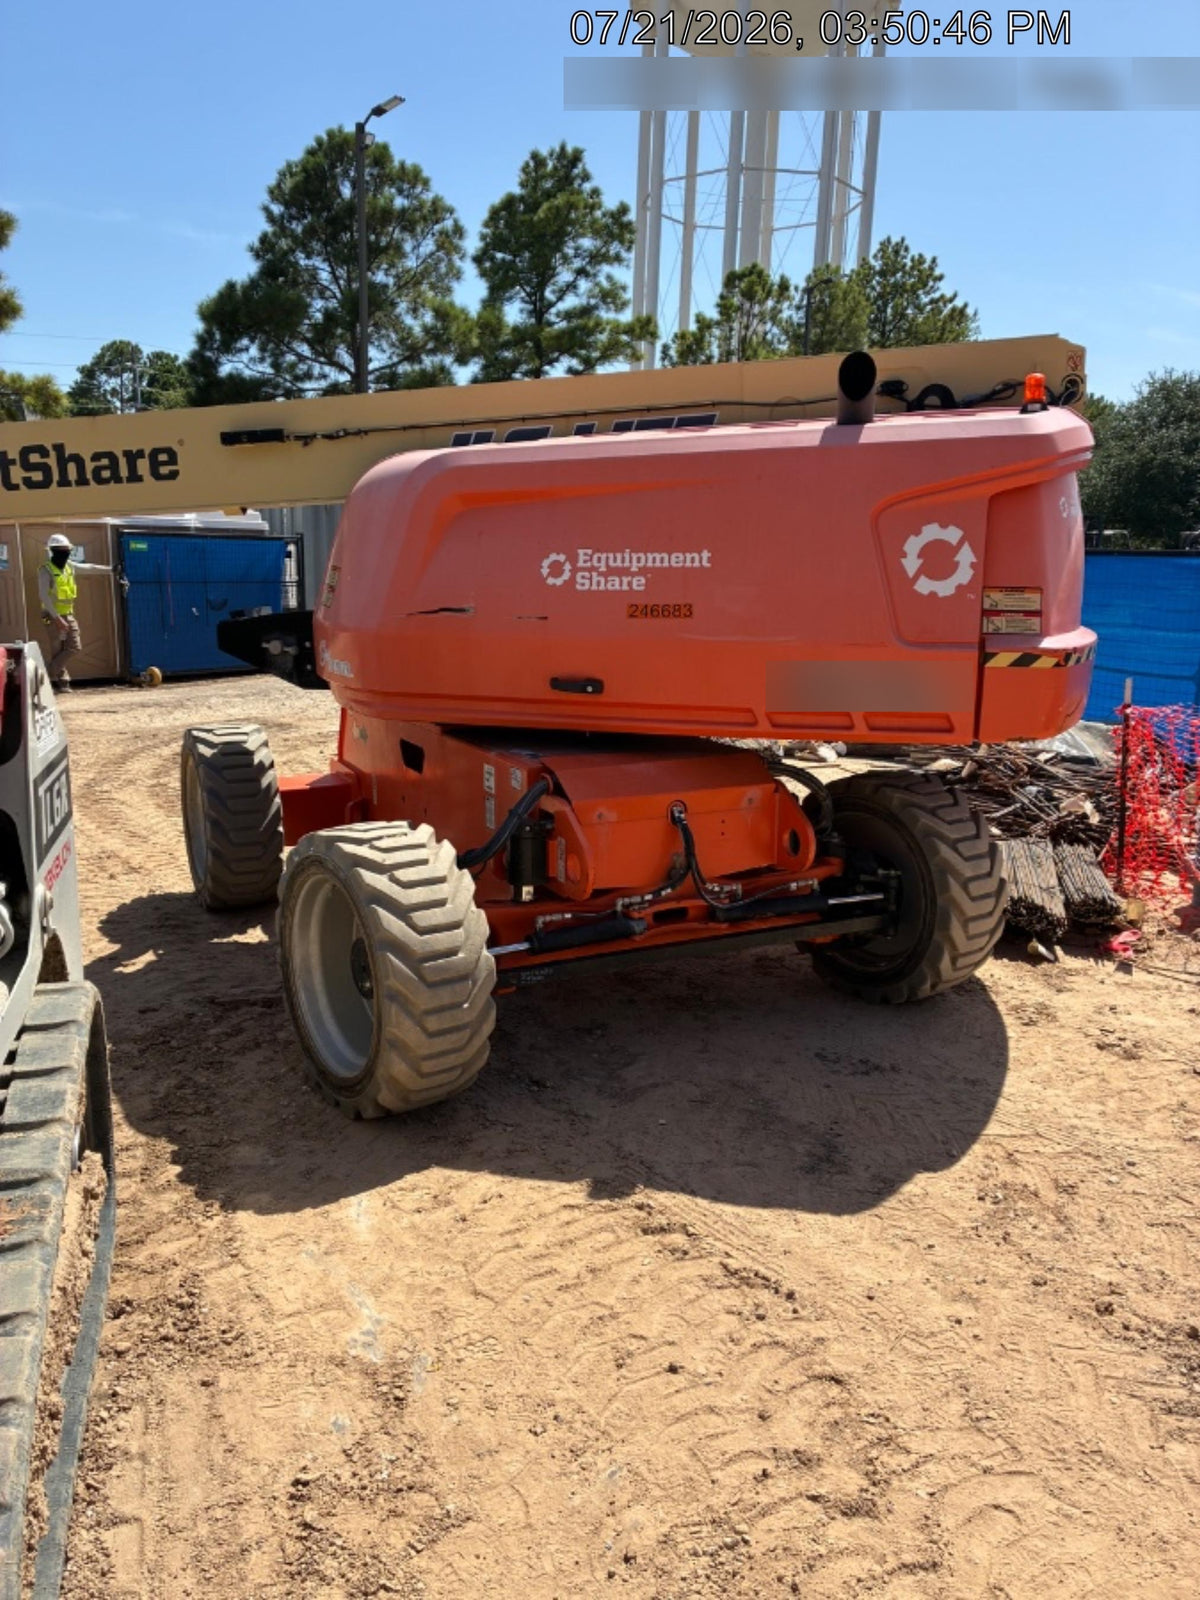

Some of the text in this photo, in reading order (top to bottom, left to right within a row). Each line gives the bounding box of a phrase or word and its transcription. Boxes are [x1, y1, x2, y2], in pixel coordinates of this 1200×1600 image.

[0, 442, 180, 491] tShare
[576, 549, 712, 571] Equipment
[575, 572, 646, 591] Share
[628, 603, 694, 618] 246683
